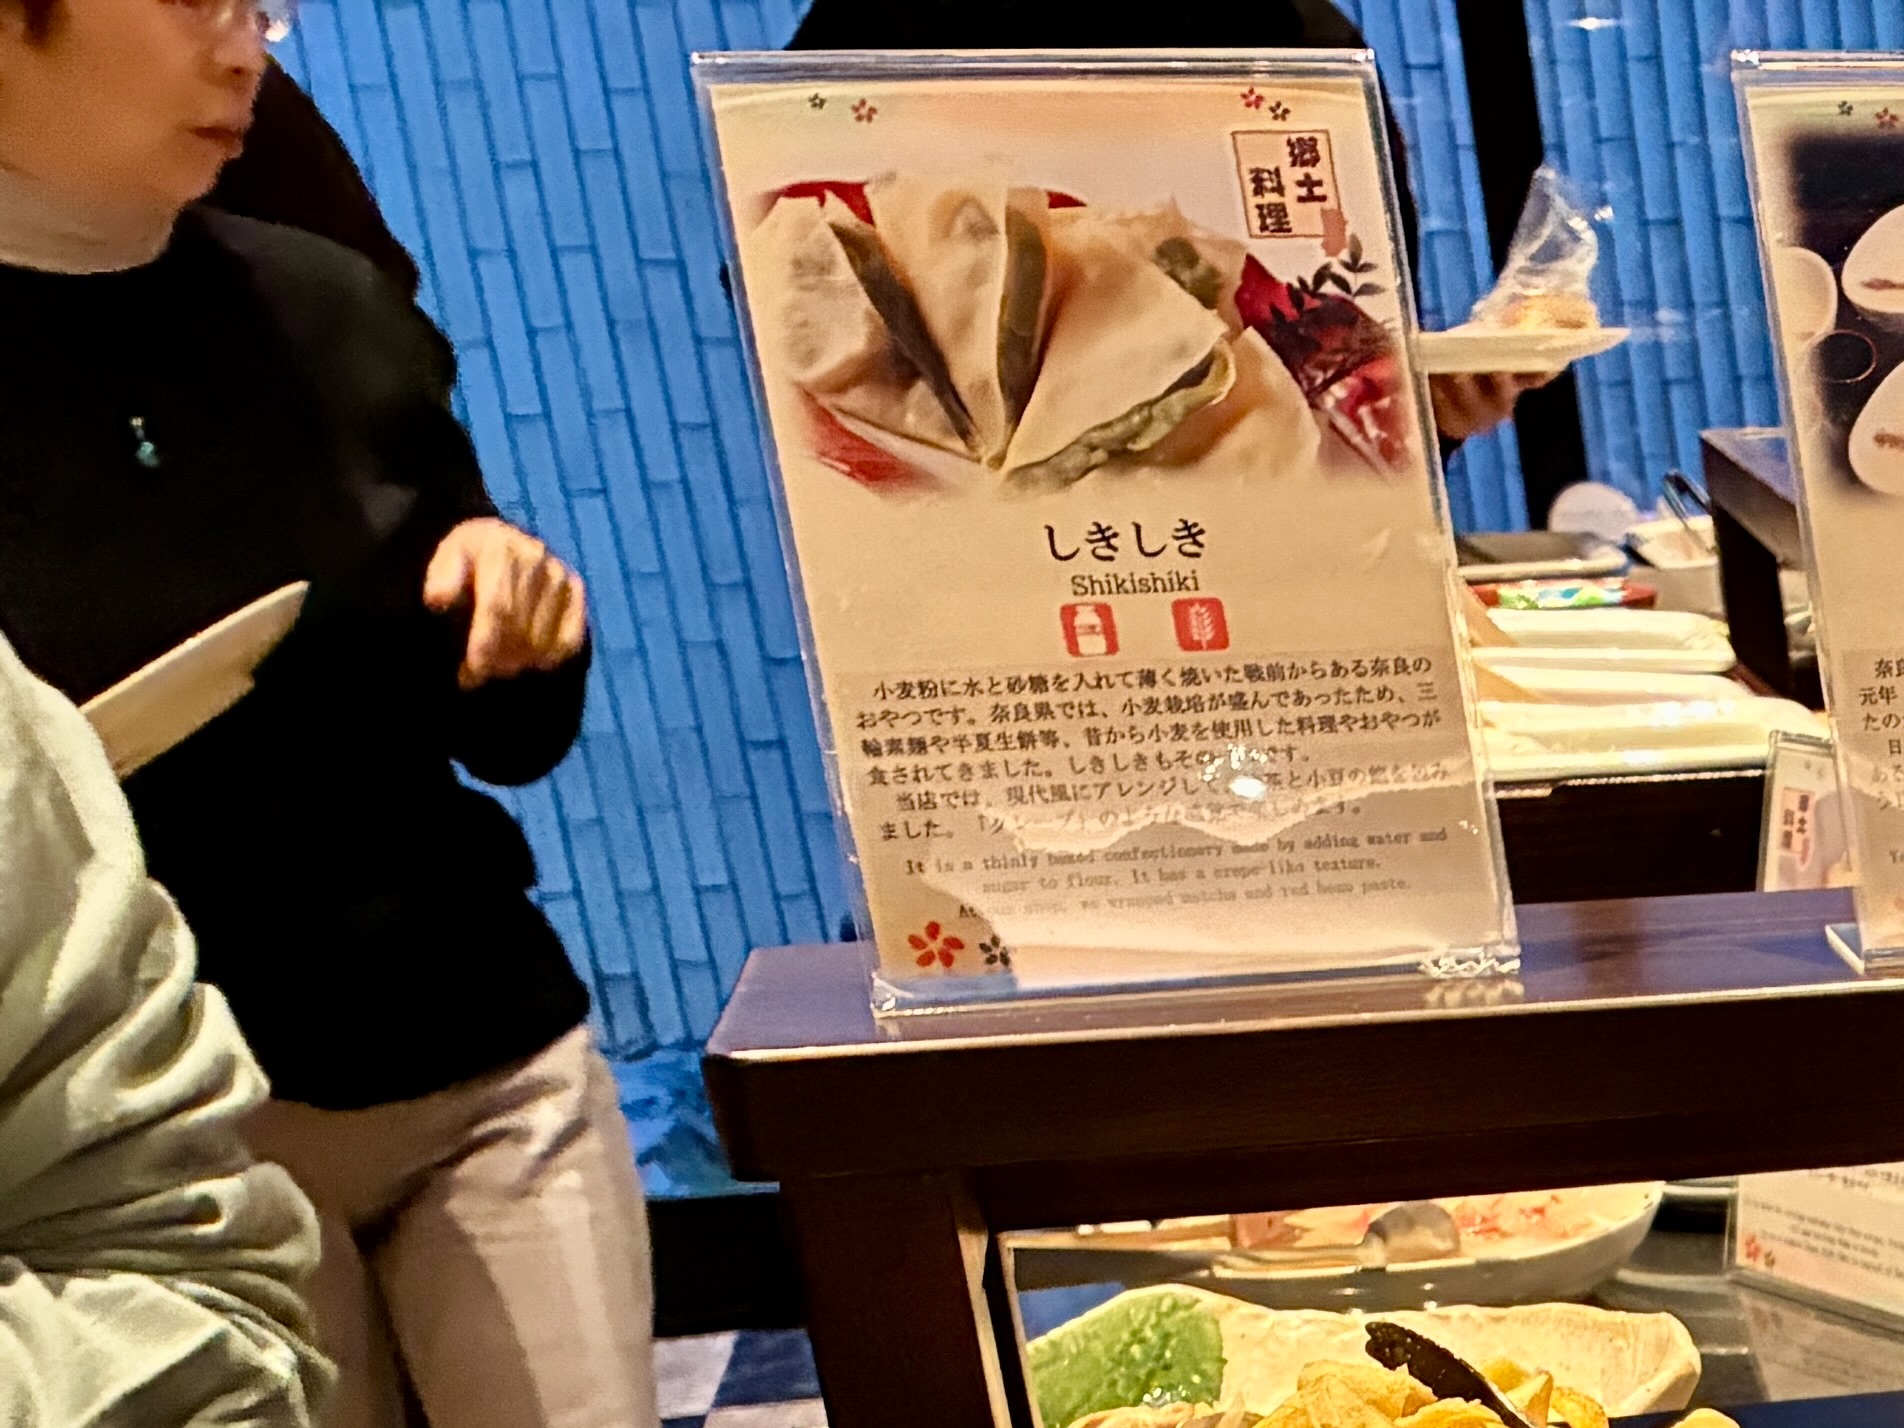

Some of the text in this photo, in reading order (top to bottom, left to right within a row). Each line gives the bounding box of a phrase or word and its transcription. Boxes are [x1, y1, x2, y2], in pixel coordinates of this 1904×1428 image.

[1044, 518, 1206, 561] しきしき
[1071, 569, 1200, 596] Shikishiki
[905, 860, 925, 876] It
[1277, 838, 1295, 853] by
[1303, 832, 1360, 850] adding
[1367, 832, 1411, 846] water
